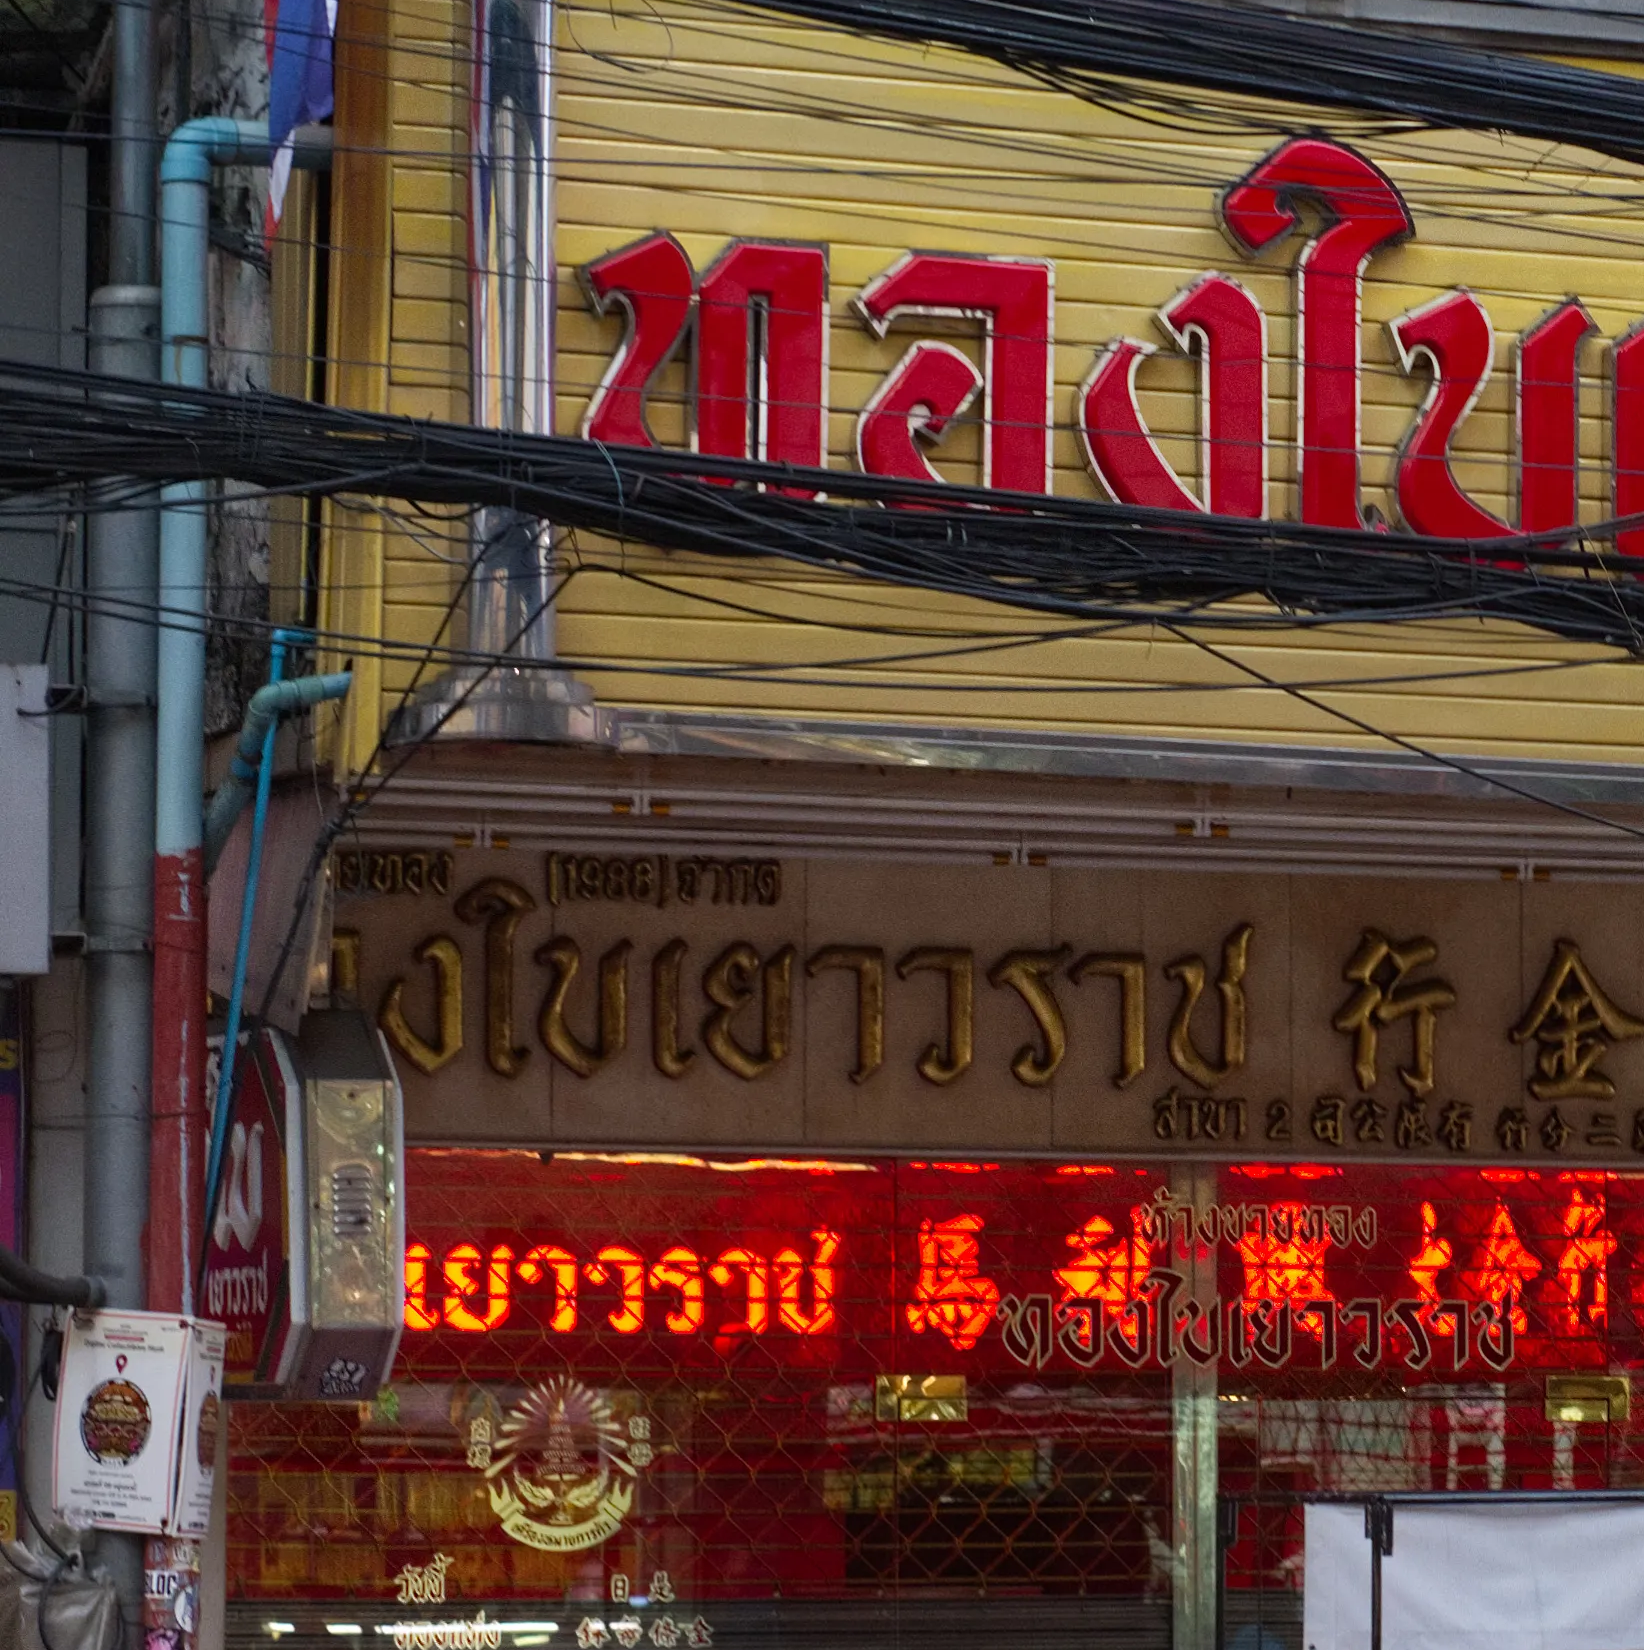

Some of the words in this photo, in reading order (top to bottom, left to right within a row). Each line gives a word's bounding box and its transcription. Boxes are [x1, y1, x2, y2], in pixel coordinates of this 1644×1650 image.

[1153, 1086, 1249, 1140] สาขา
[1266, 1101, 1292, 1140] 2
[1141, 1186, 1379, 1249] ห้างขายทอง
[998, 1267, 1516, 1372] ทองใบเยาวราช
